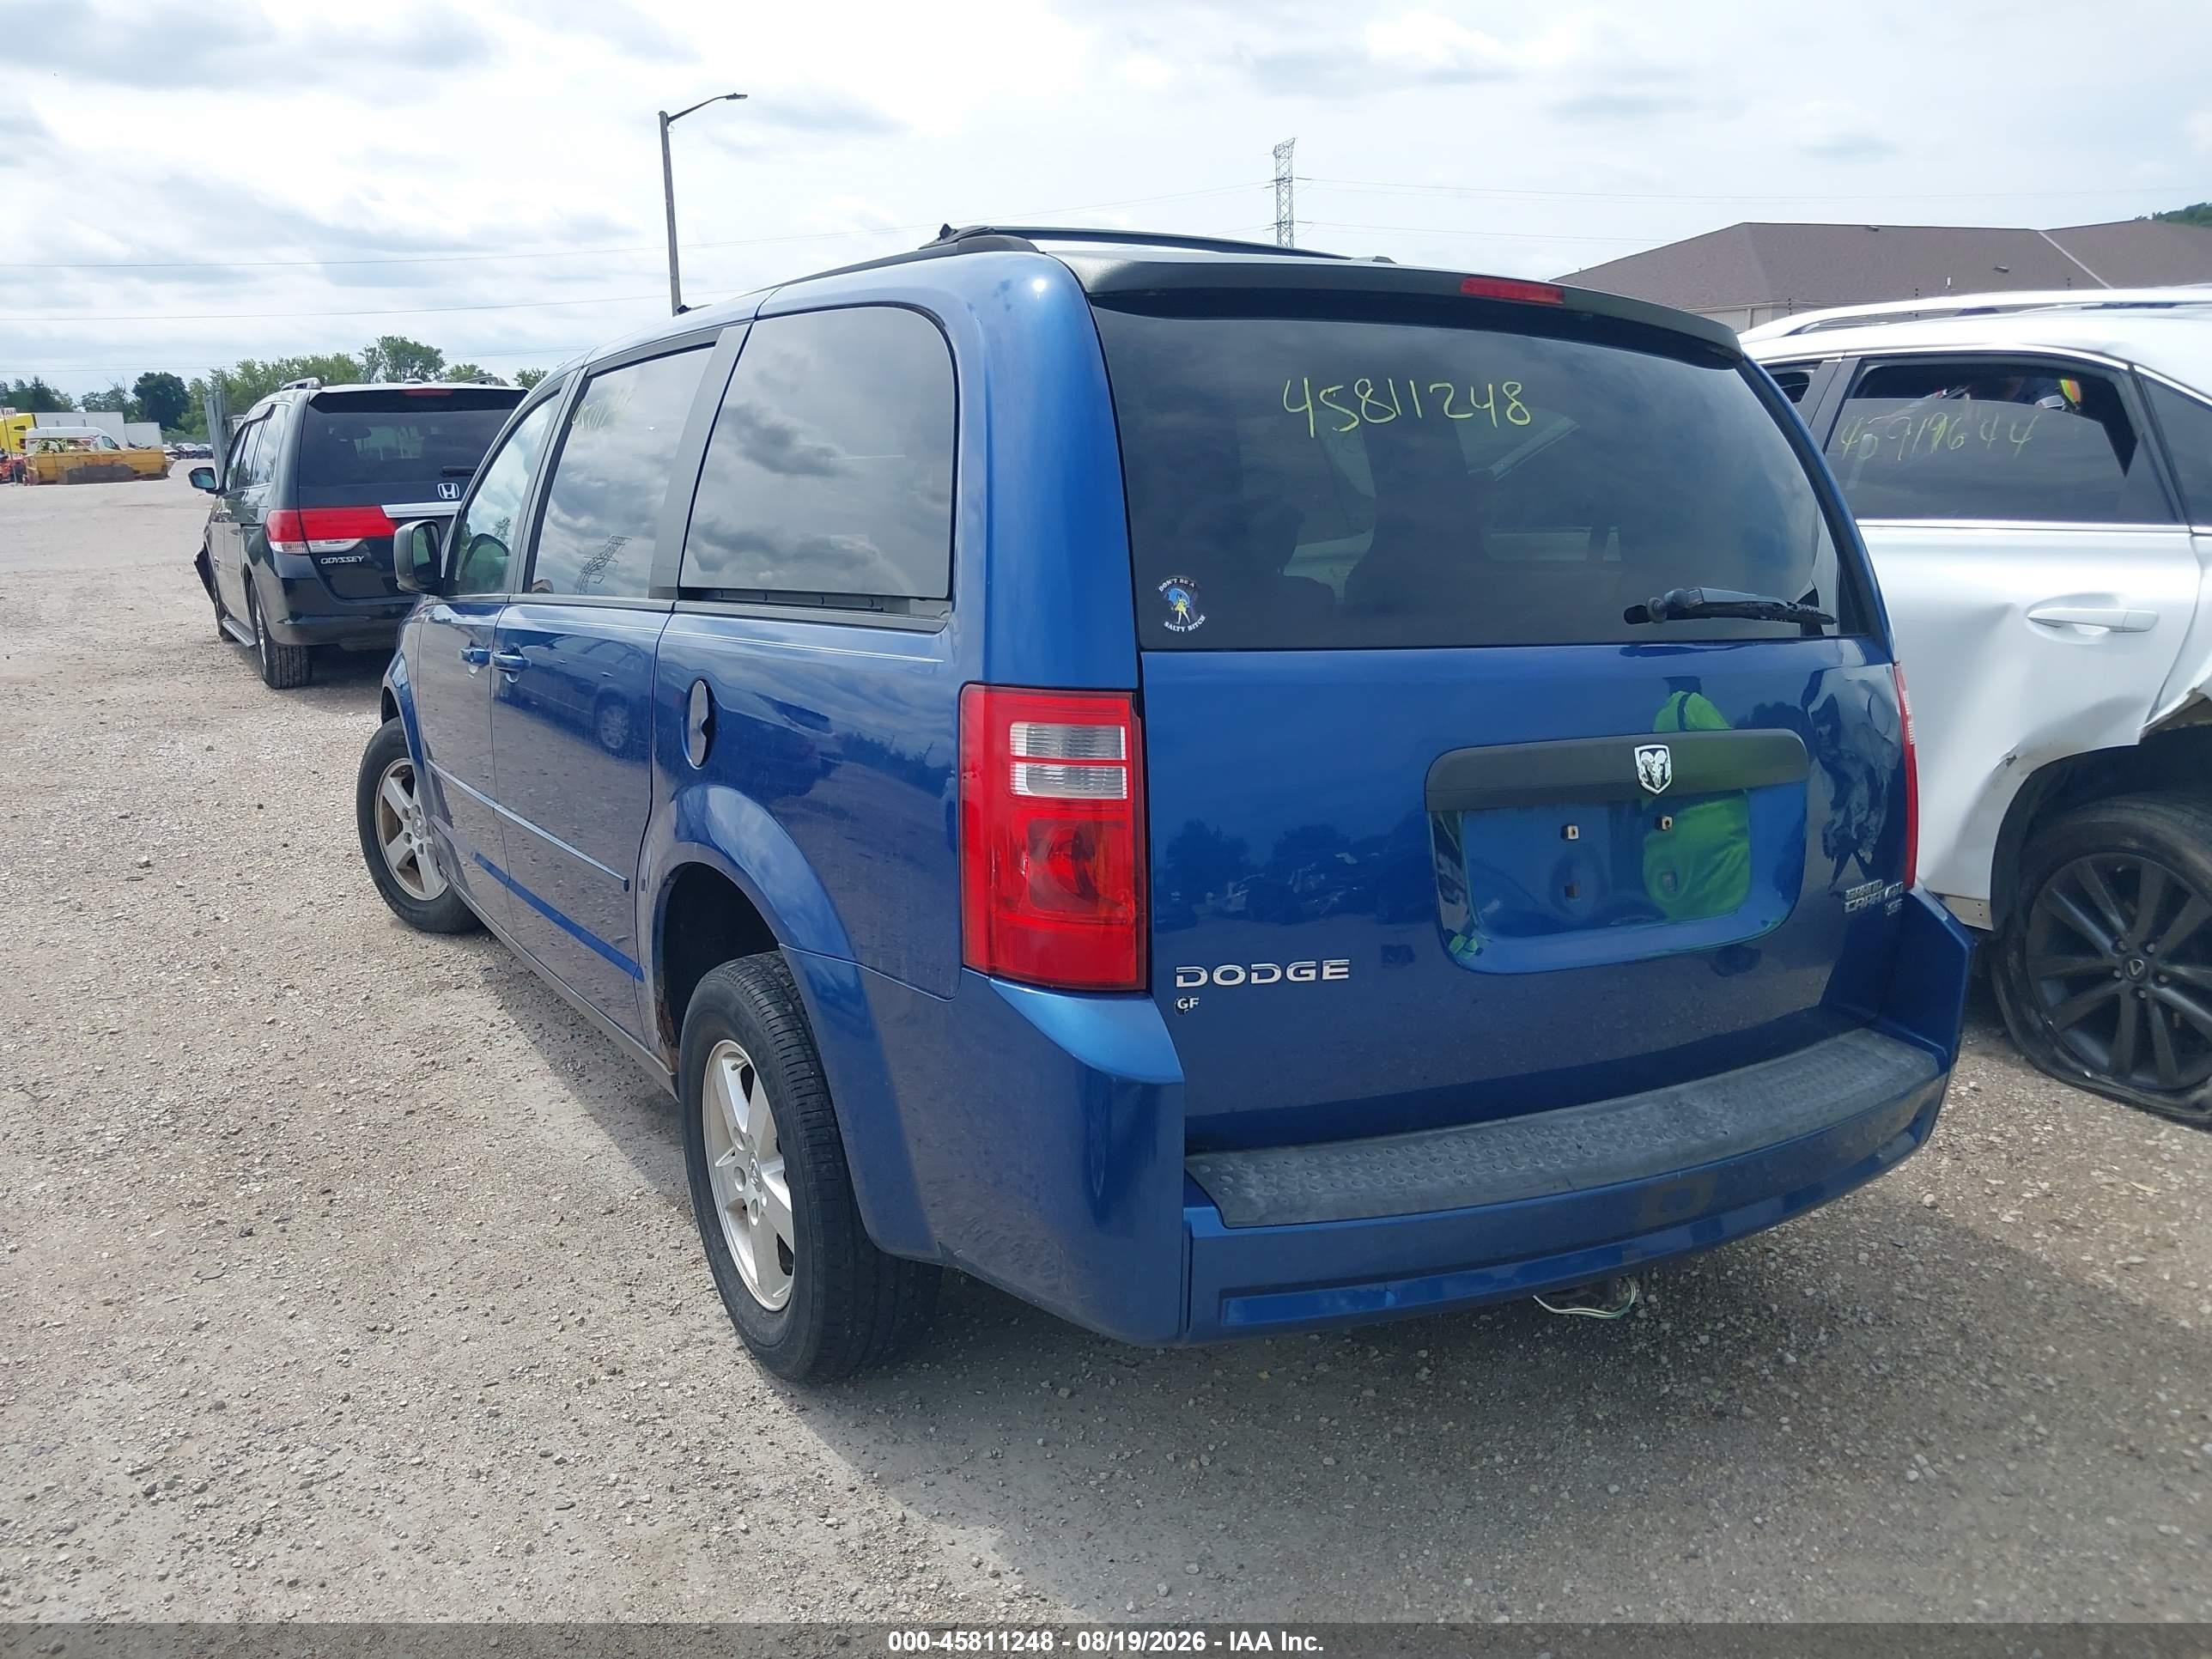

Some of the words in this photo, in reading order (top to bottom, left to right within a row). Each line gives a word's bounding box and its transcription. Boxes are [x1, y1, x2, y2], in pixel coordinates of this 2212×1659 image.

[1283, 377, 1531, 438] 45811248
[320, 556, 364, 565] ODYSSEY
[1158, 578, 1177, 592] DON'T
[1164, 621, 1186, 633] SALTY
[1187, 614, 1206, 632] BITCH
[1176, 959, 1351, 988] DODGE
